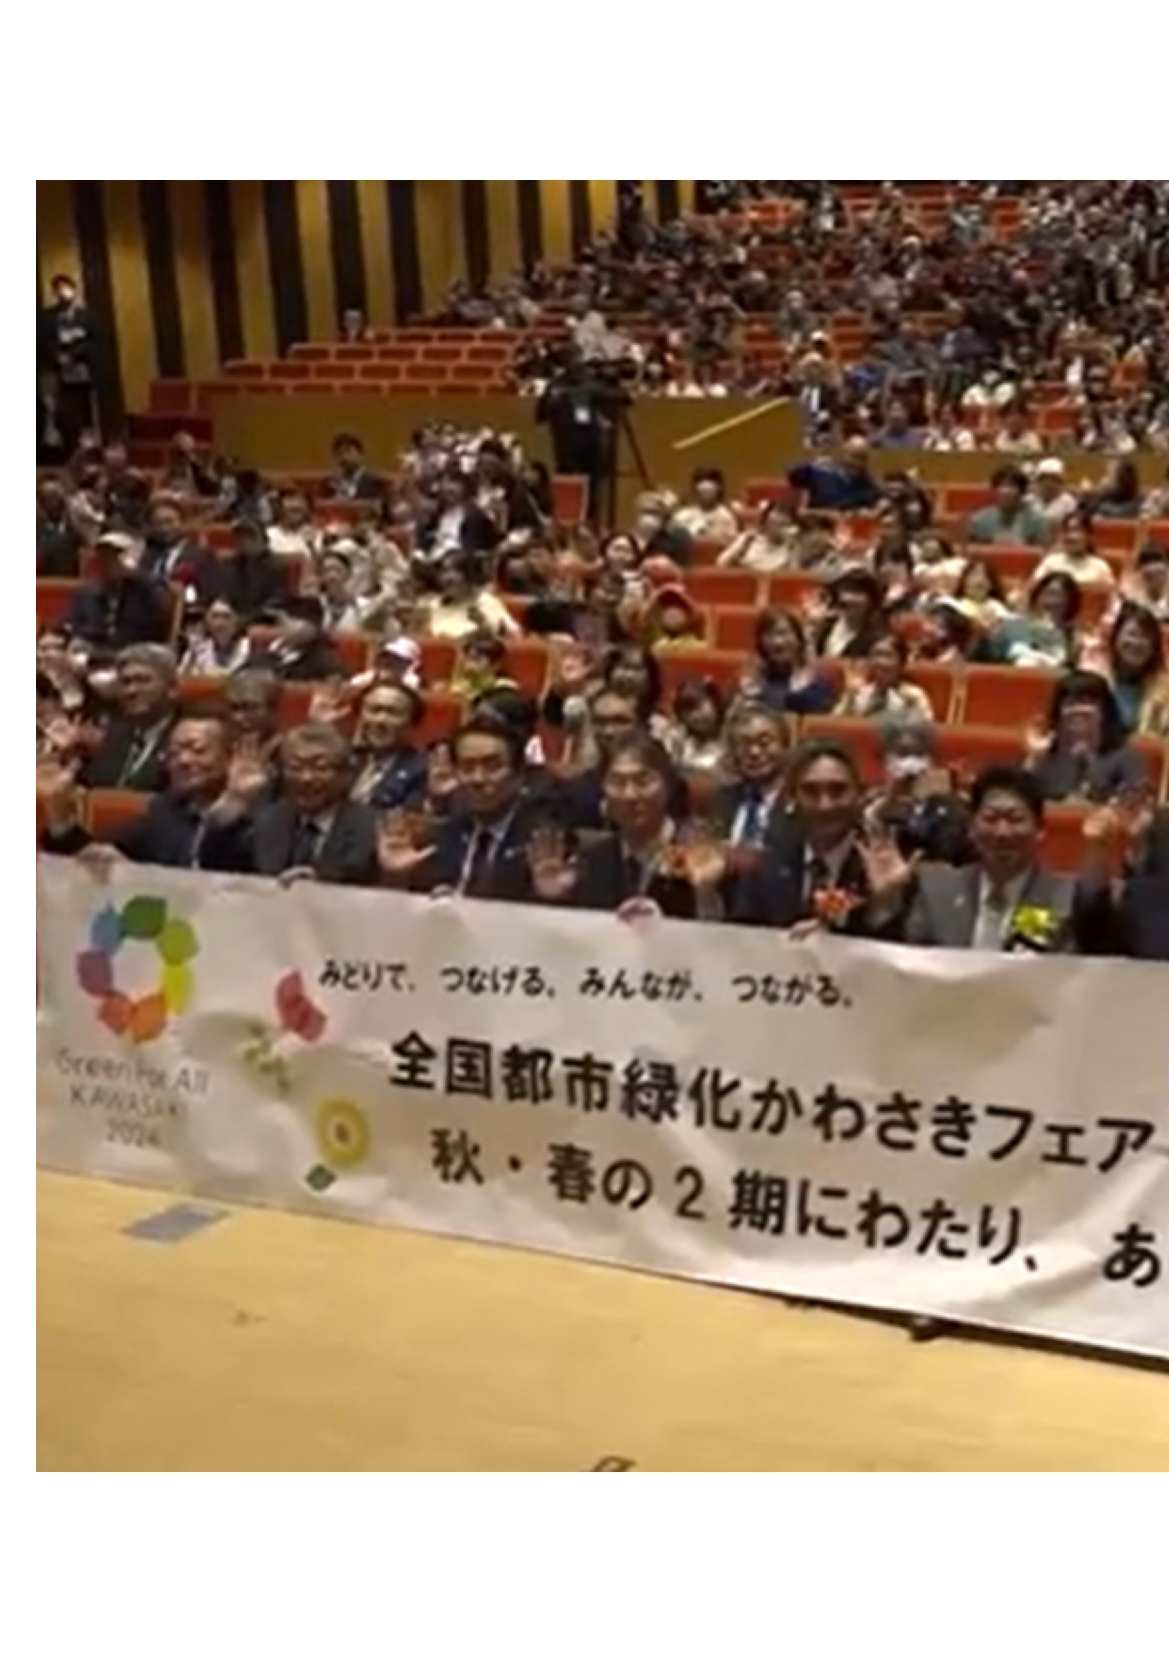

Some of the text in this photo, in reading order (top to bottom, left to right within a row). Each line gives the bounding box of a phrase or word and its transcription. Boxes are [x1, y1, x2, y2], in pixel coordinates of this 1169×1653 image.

[388, 1030, 1156, 1174] 全国都市緑化かわさきフェア
